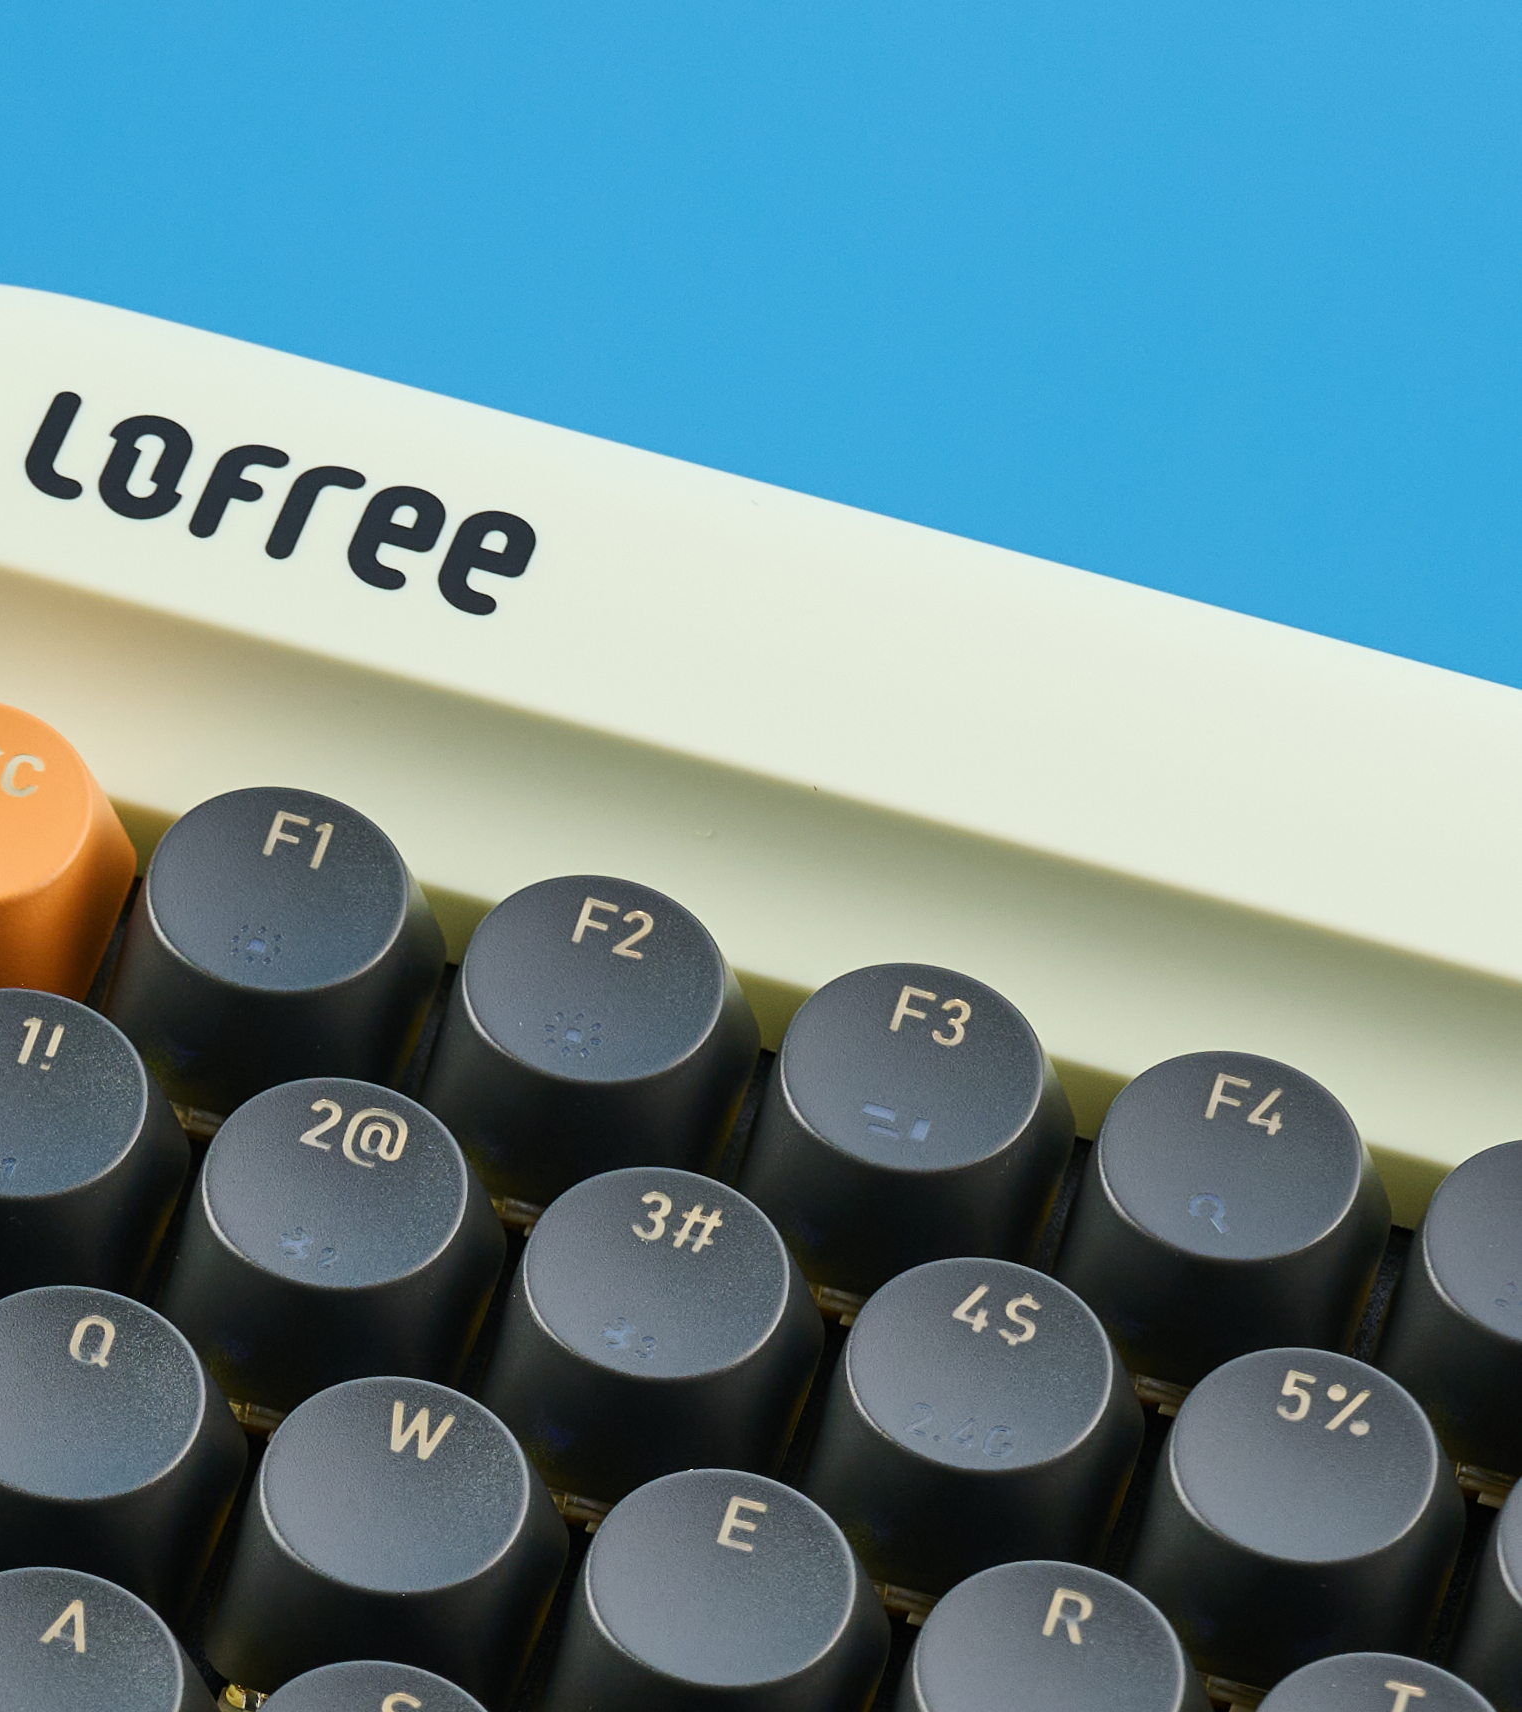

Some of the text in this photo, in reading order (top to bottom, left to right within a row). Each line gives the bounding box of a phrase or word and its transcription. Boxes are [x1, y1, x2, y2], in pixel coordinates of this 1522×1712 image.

[262, 810, 334, 870] F1
[571, 896, 655, 960] F2
[889, 985, 972, 1047] F3
[300, 1098, 409, 1168] 2@
[1204, 1072, 1283, 1136] F4
[633, 1190, 723, 1253] 3#
[69, 1314, 116, 1368] Q
[952, 1284, 1042, 1346] 4$
[390, 1400, 456, 1461] W
[902, 1402, 1014, 1458] 2.4G
[1277, 1369, 1371, 1436] 5%
[717, 1495, 768, 1552] E
[39, 1598, 86, 1654] A
[1041, 1587, 1094, 1644] R
